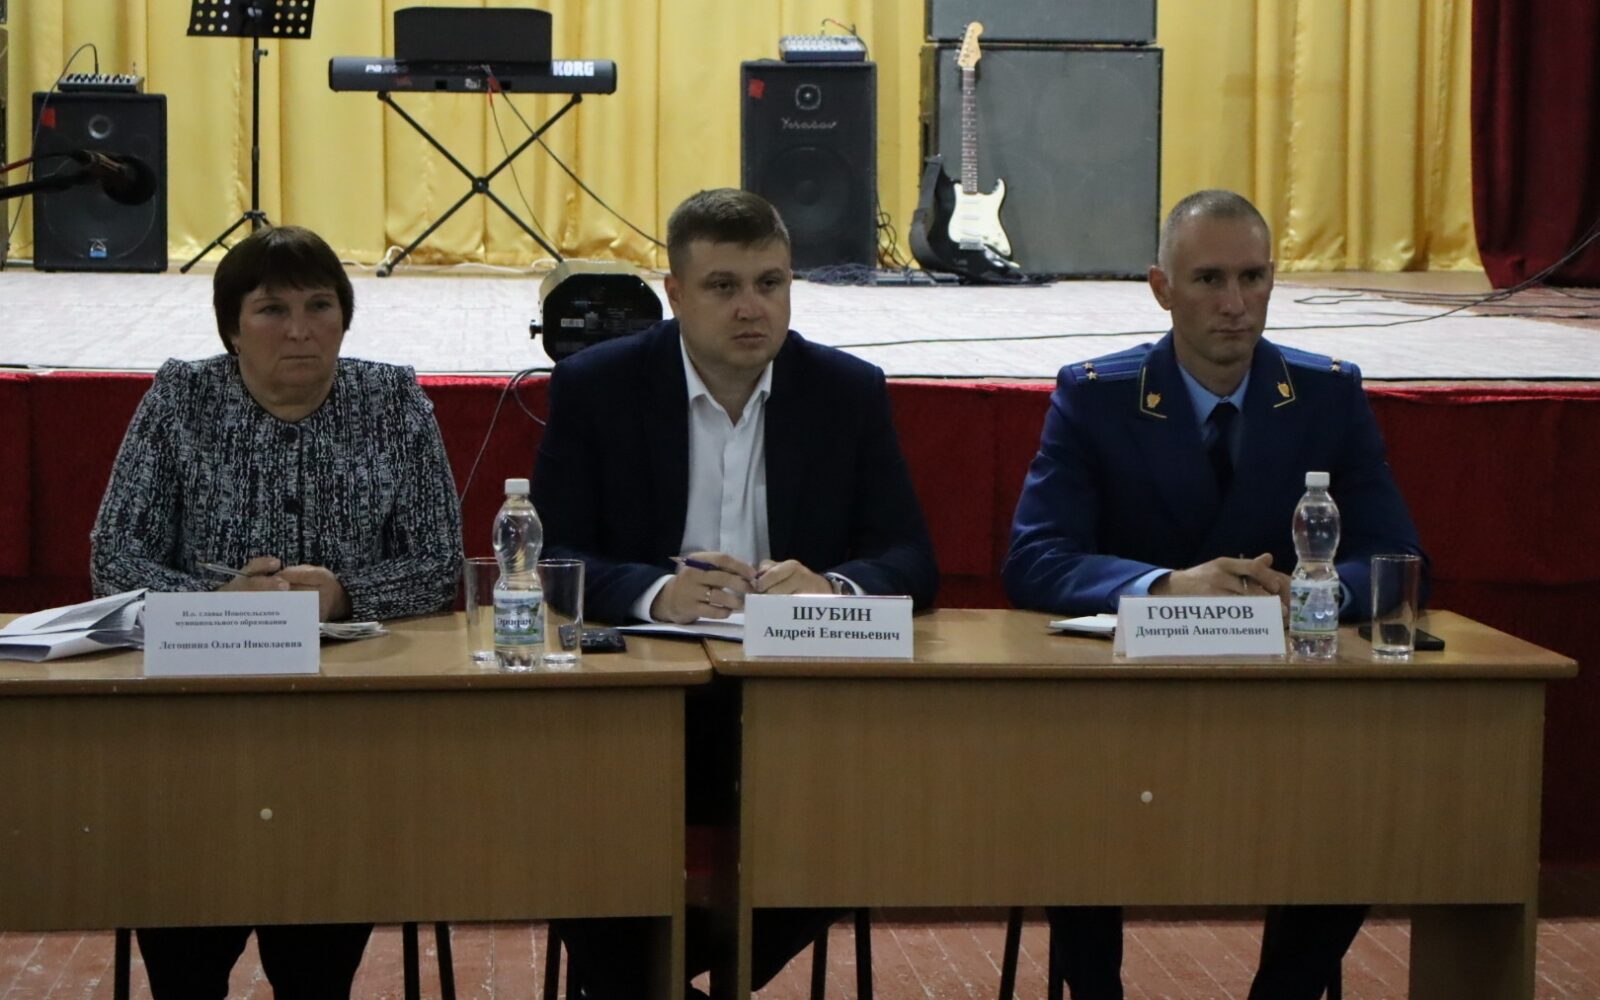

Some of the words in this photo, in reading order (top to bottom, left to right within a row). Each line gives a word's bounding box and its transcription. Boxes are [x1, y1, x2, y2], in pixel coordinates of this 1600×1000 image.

[553, 61, 595, 77] KORG
[792, 606, 872, 622] ШУБИН
[1147, 605, 1254, 620] ГОНЧАРОВ
[240, 619, 287, 627] образования
[764, 626, 815, 640] Андрей
[819, 627, 900, 641] Евгеньевич
[1135, 625, 1189, 638] Дмитрий
[1192, 625, 1269, 636] Анатольевич
[159, 641, 208, 650] Легошина
[211, 640, 241, 649] Ольга
[243, 640, 302, 649] Николаевна
